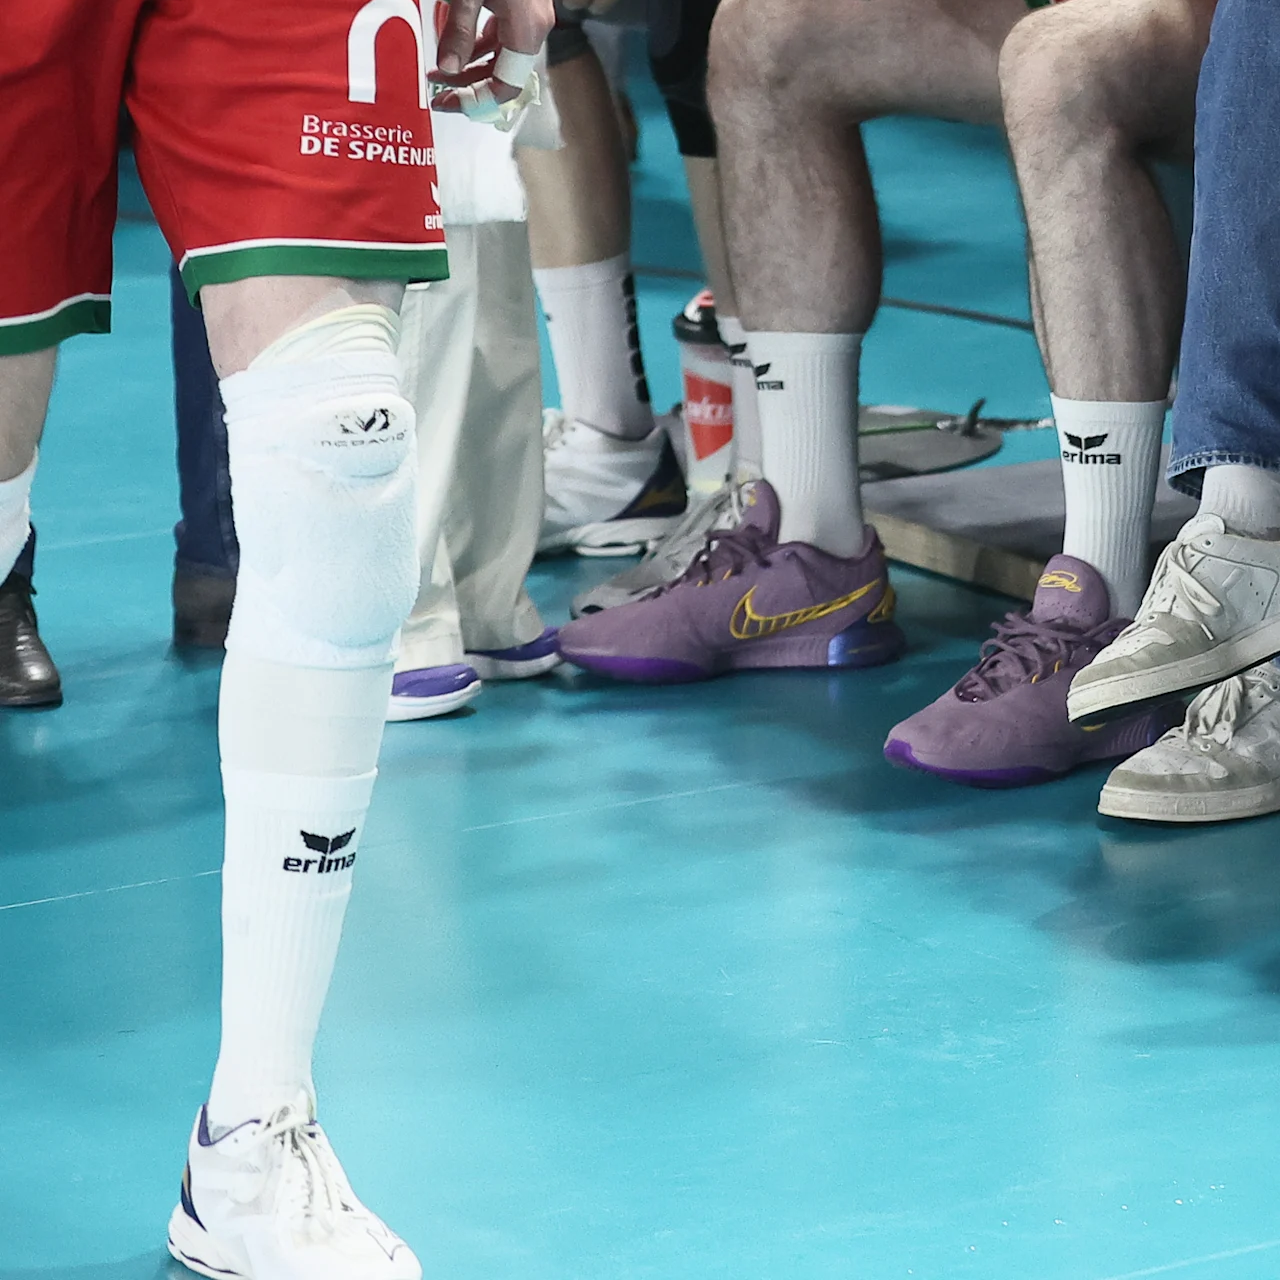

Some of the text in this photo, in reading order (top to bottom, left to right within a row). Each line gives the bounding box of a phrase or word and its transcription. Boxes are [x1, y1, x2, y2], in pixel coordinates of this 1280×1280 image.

[302, 114, 414, 146] Brasserie
[300, 135, 340, 158] DE
[1062, 449, 1122, 466] erima
[282, 851, 357, 875] erima
